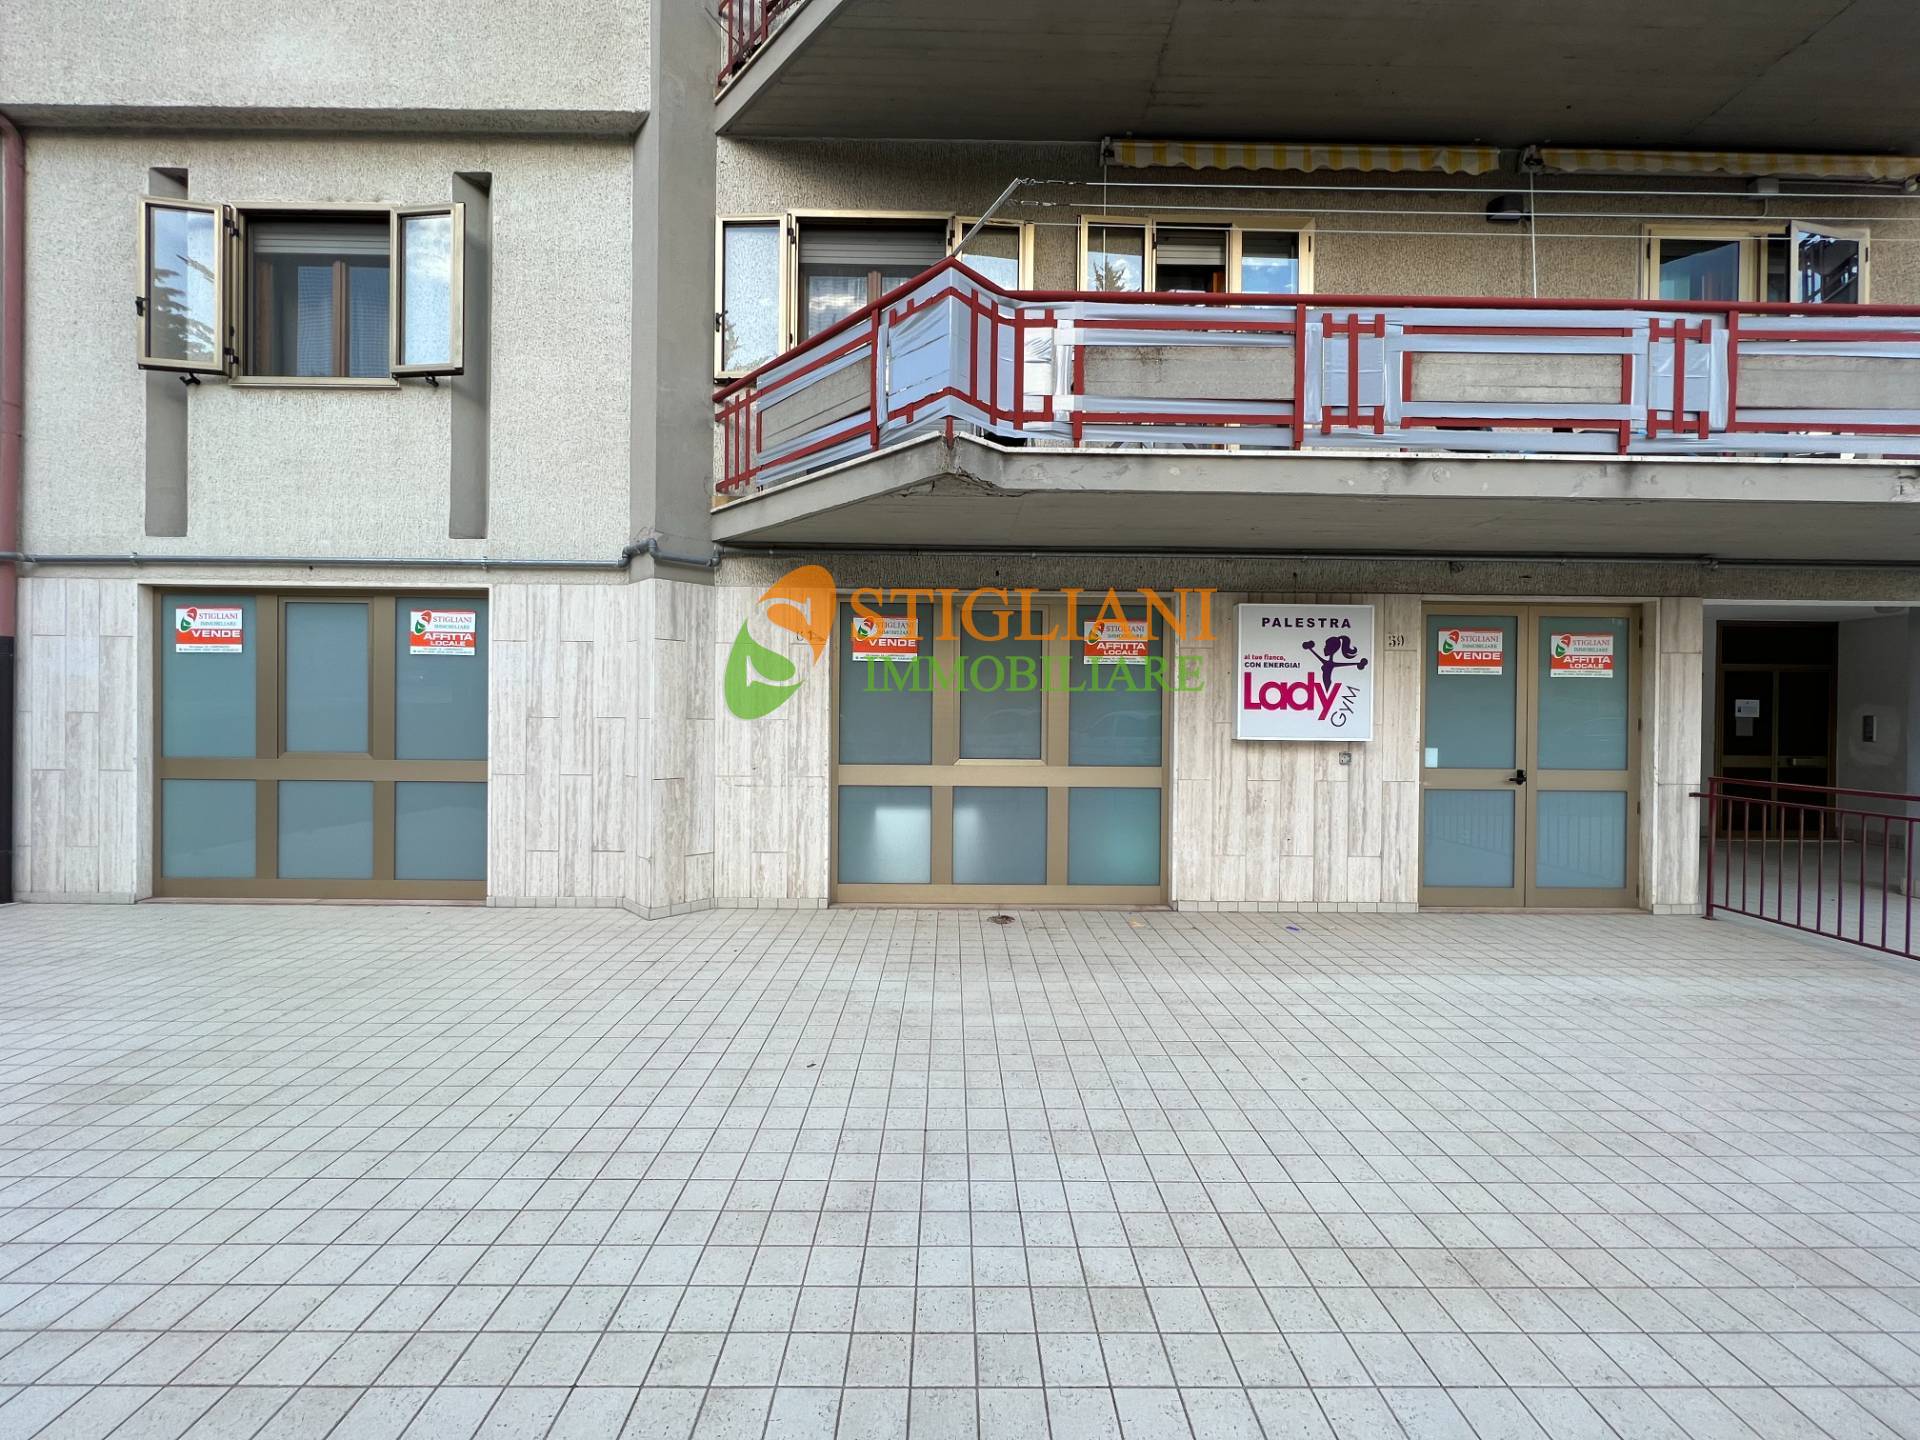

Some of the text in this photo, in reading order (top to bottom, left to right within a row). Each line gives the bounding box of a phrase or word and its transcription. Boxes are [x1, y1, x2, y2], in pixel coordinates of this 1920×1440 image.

[198, 612, 238, 620] STIGLIANI
[432, 615, 472, 623] STIGLIANI
[1261, 617, 1352, 629] PALESTRA
[191, 629, 241, 638] VENDE
[423, 632, 473, 641] AFFITTA
[868, 638, 916, 647] VENDE
[1460, 635, 1499, 643] STIGLIANI
[1096, 642, 1146, 650] AFFITTA
[1263, 653, 1286, 661] fianco,
[1453, 652, 1501, 660] VENDE
[1563, 655, 1611, 663] AFFITTA
[1244, 661, 1261, 669] CON
[1243, 671, 1342, 721] Lady
[1330, 685, 1361, 727] GYM
